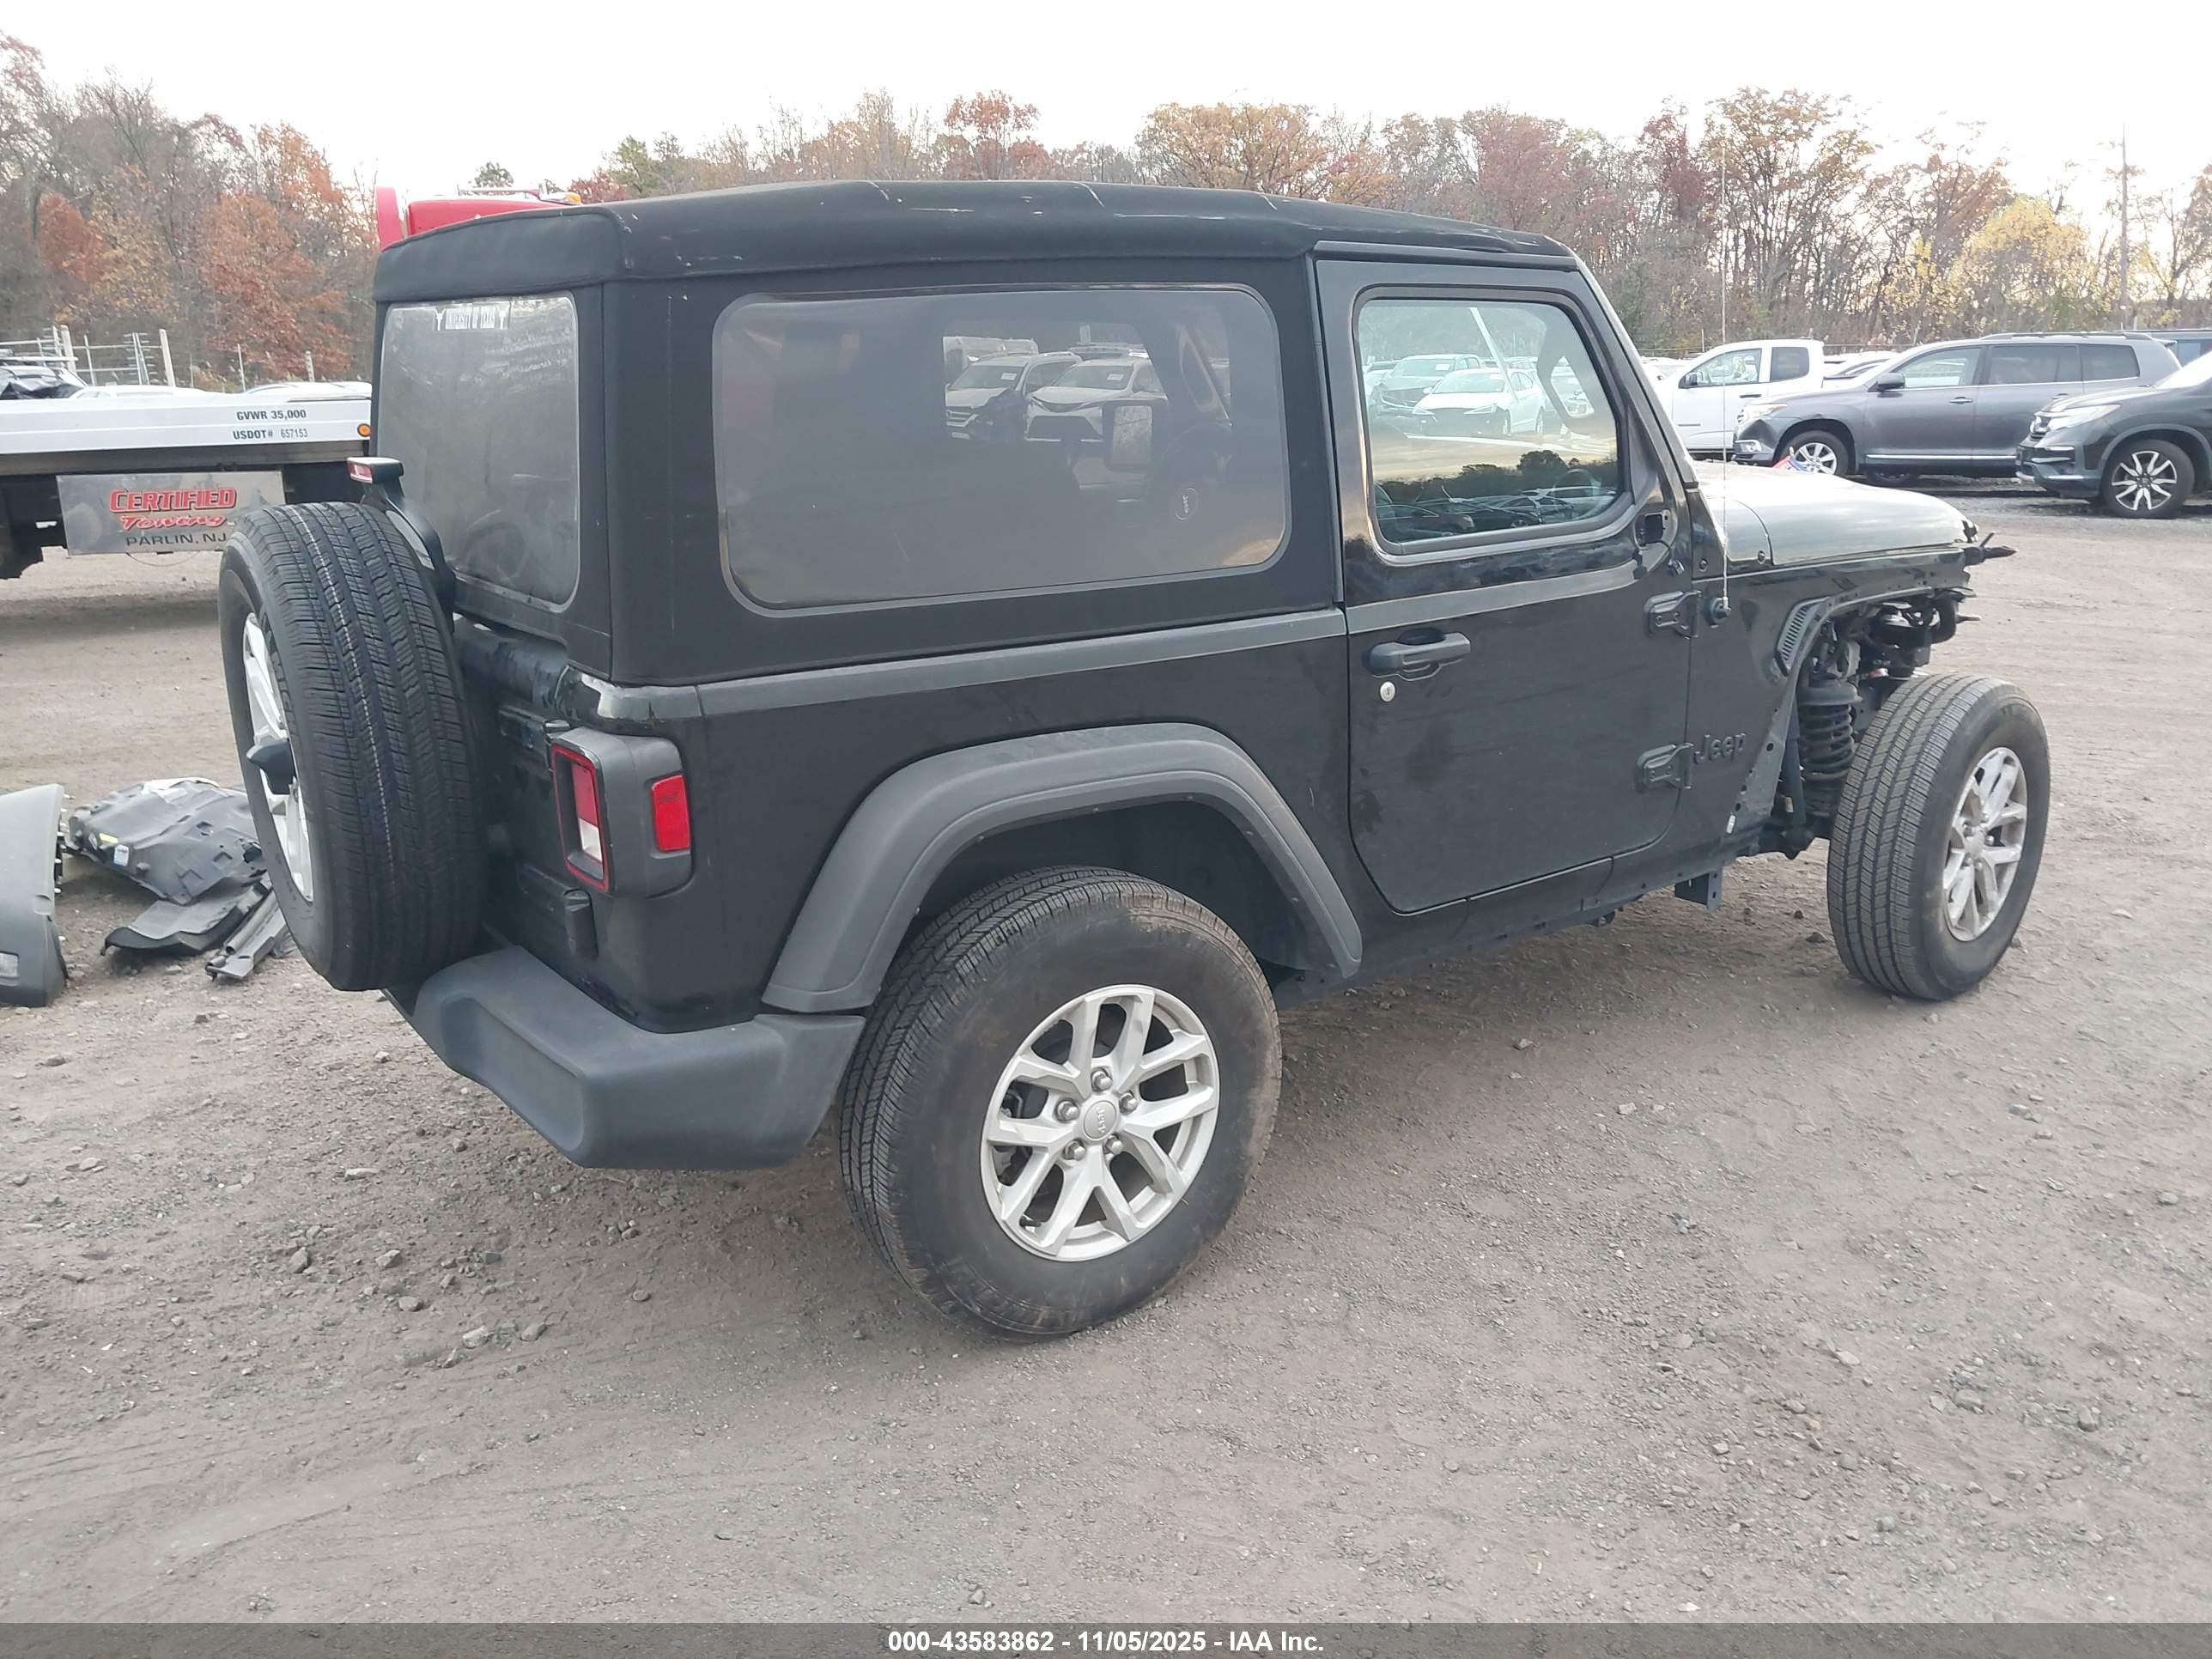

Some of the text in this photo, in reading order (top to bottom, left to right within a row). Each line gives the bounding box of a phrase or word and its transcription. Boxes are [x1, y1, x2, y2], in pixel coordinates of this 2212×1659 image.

[236, 409, 307, 421] GVWR 35,000
[233, 428, 308, 440] USDOT# 657153
[110, 488, 237, 513] CERTIFIED
[120, 515, 227, 531] Towing
[203, 532, 228, 543] NJ
[1692, 732, 1746, 764] Jeep
